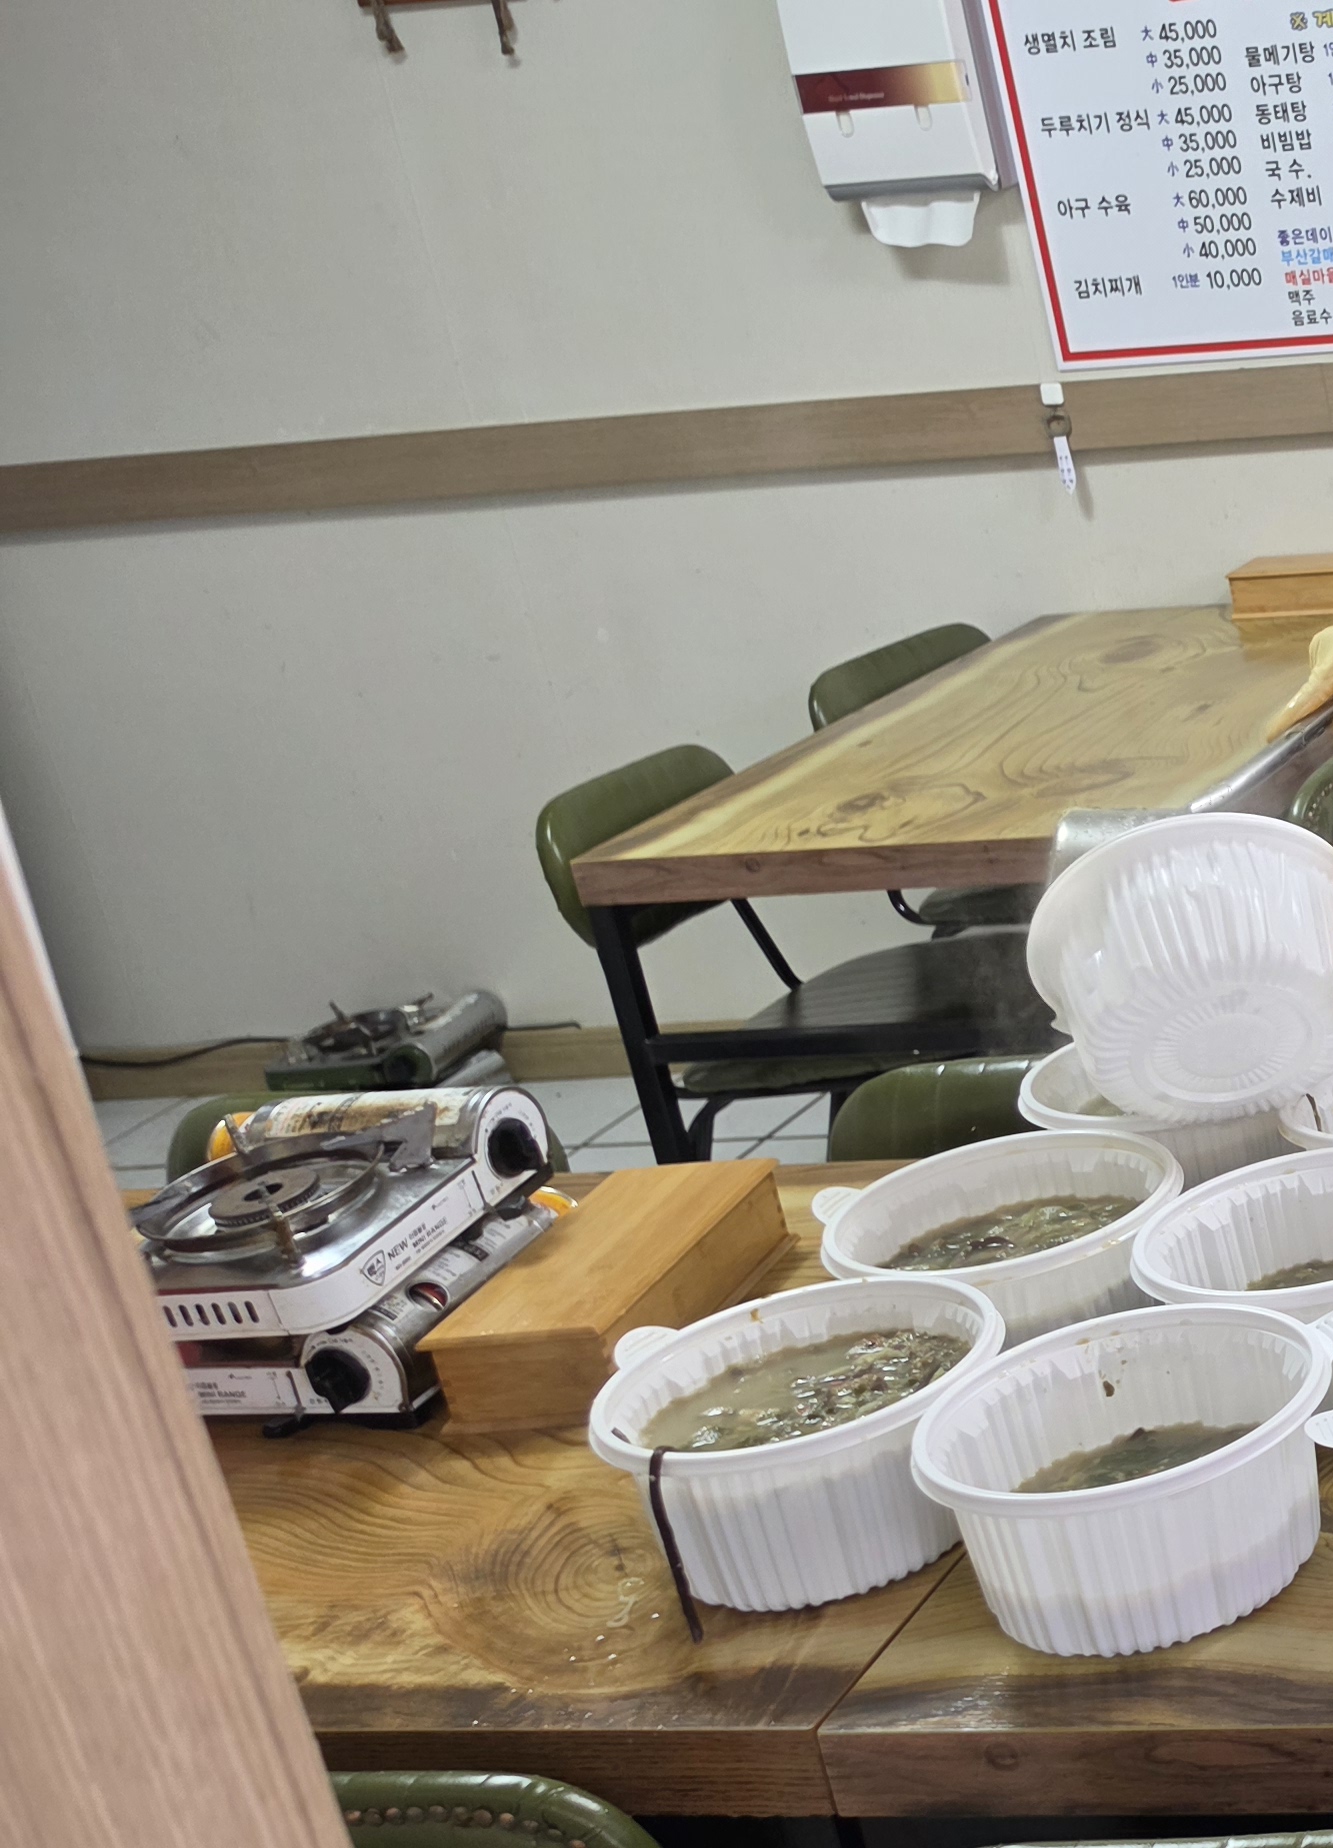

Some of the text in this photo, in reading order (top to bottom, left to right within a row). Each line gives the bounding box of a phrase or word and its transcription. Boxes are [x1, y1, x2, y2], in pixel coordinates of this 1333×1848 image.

[1024, 19, 1217, 55] 생멸치 조림 大 45,000
[1146, 45, 1222, 69] 中 35,000
[1244, 41, 1315, 68] 물메기탕
[1151, 72, 1227, 95] 小 25,000
[1250, 71, 1302, 97] 아구탕
[1041, 103, 1233, 138] 두루치기 정식 大 45,000
[1255, 100, 1307, 125] 동태탕
[1162, 130, 1237, 154] 中 35,000
[1260, 129, 1312, 153] 비빔밥
[1168, 156, 1242, 179] 小 25,000
[1264, 161, 1282, 181] 국
[1057, 186, 1247, 220] 아구 수육 大 60,000
[1270, 185, 1322, 209] 수제비
[1177, 212, 1252, 235] 中 50,000
[1277, 226, 1333, 246] 좋은데이
[1183, 238, 1257, 260] 小 40,000
[1074, 268, 1262, 300] 김치찌개 1인분 10,000
[1288, 289, 1315, 306] 맥주
[1291, 309, 1333, 327] 음료수
[387, 1237, 408, 1260] NEW
